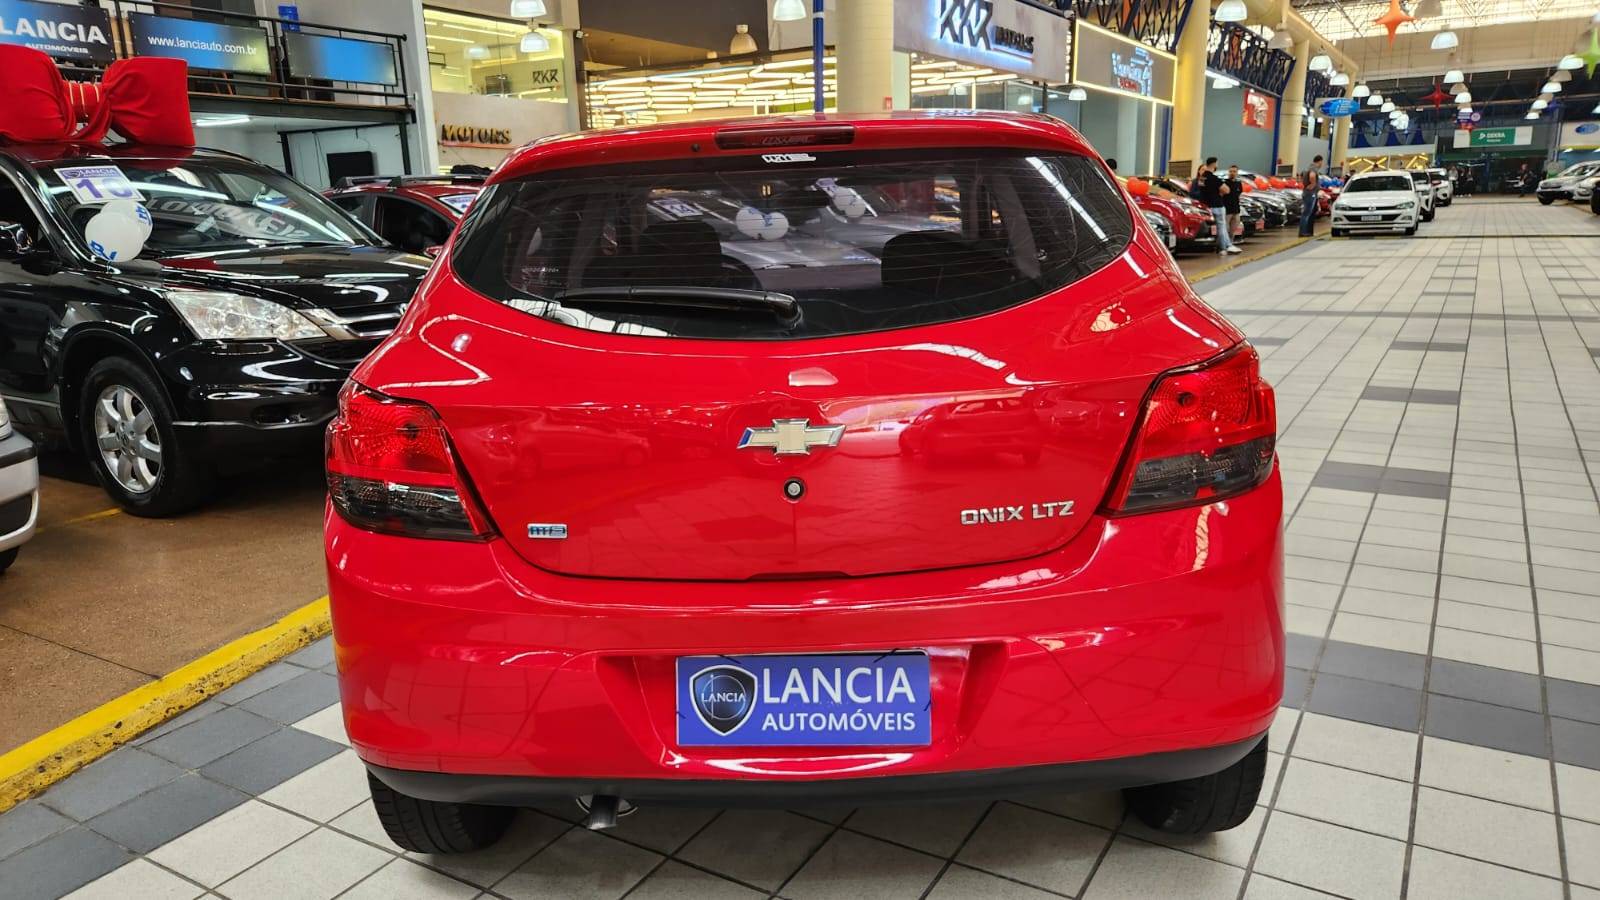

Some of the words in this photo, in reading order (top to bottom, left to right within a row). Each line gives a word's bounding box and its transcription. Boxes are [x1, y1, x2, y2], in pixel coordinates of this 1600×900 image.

[0, 15, 108, 45] LANCIA
[147, 35, 257, 55] www.lanciauto.com.br
[441, 123, 512, 145] MOTORS
[960, 505, 1024, 525] ONIX
[1031, 500, 1075, 519] LTZ
[763, 667, 916, 704] LANCIA
[700, 692, 746, 703] LANCIA
[762, 709, 916, 731] AUTOMÓVEIS
